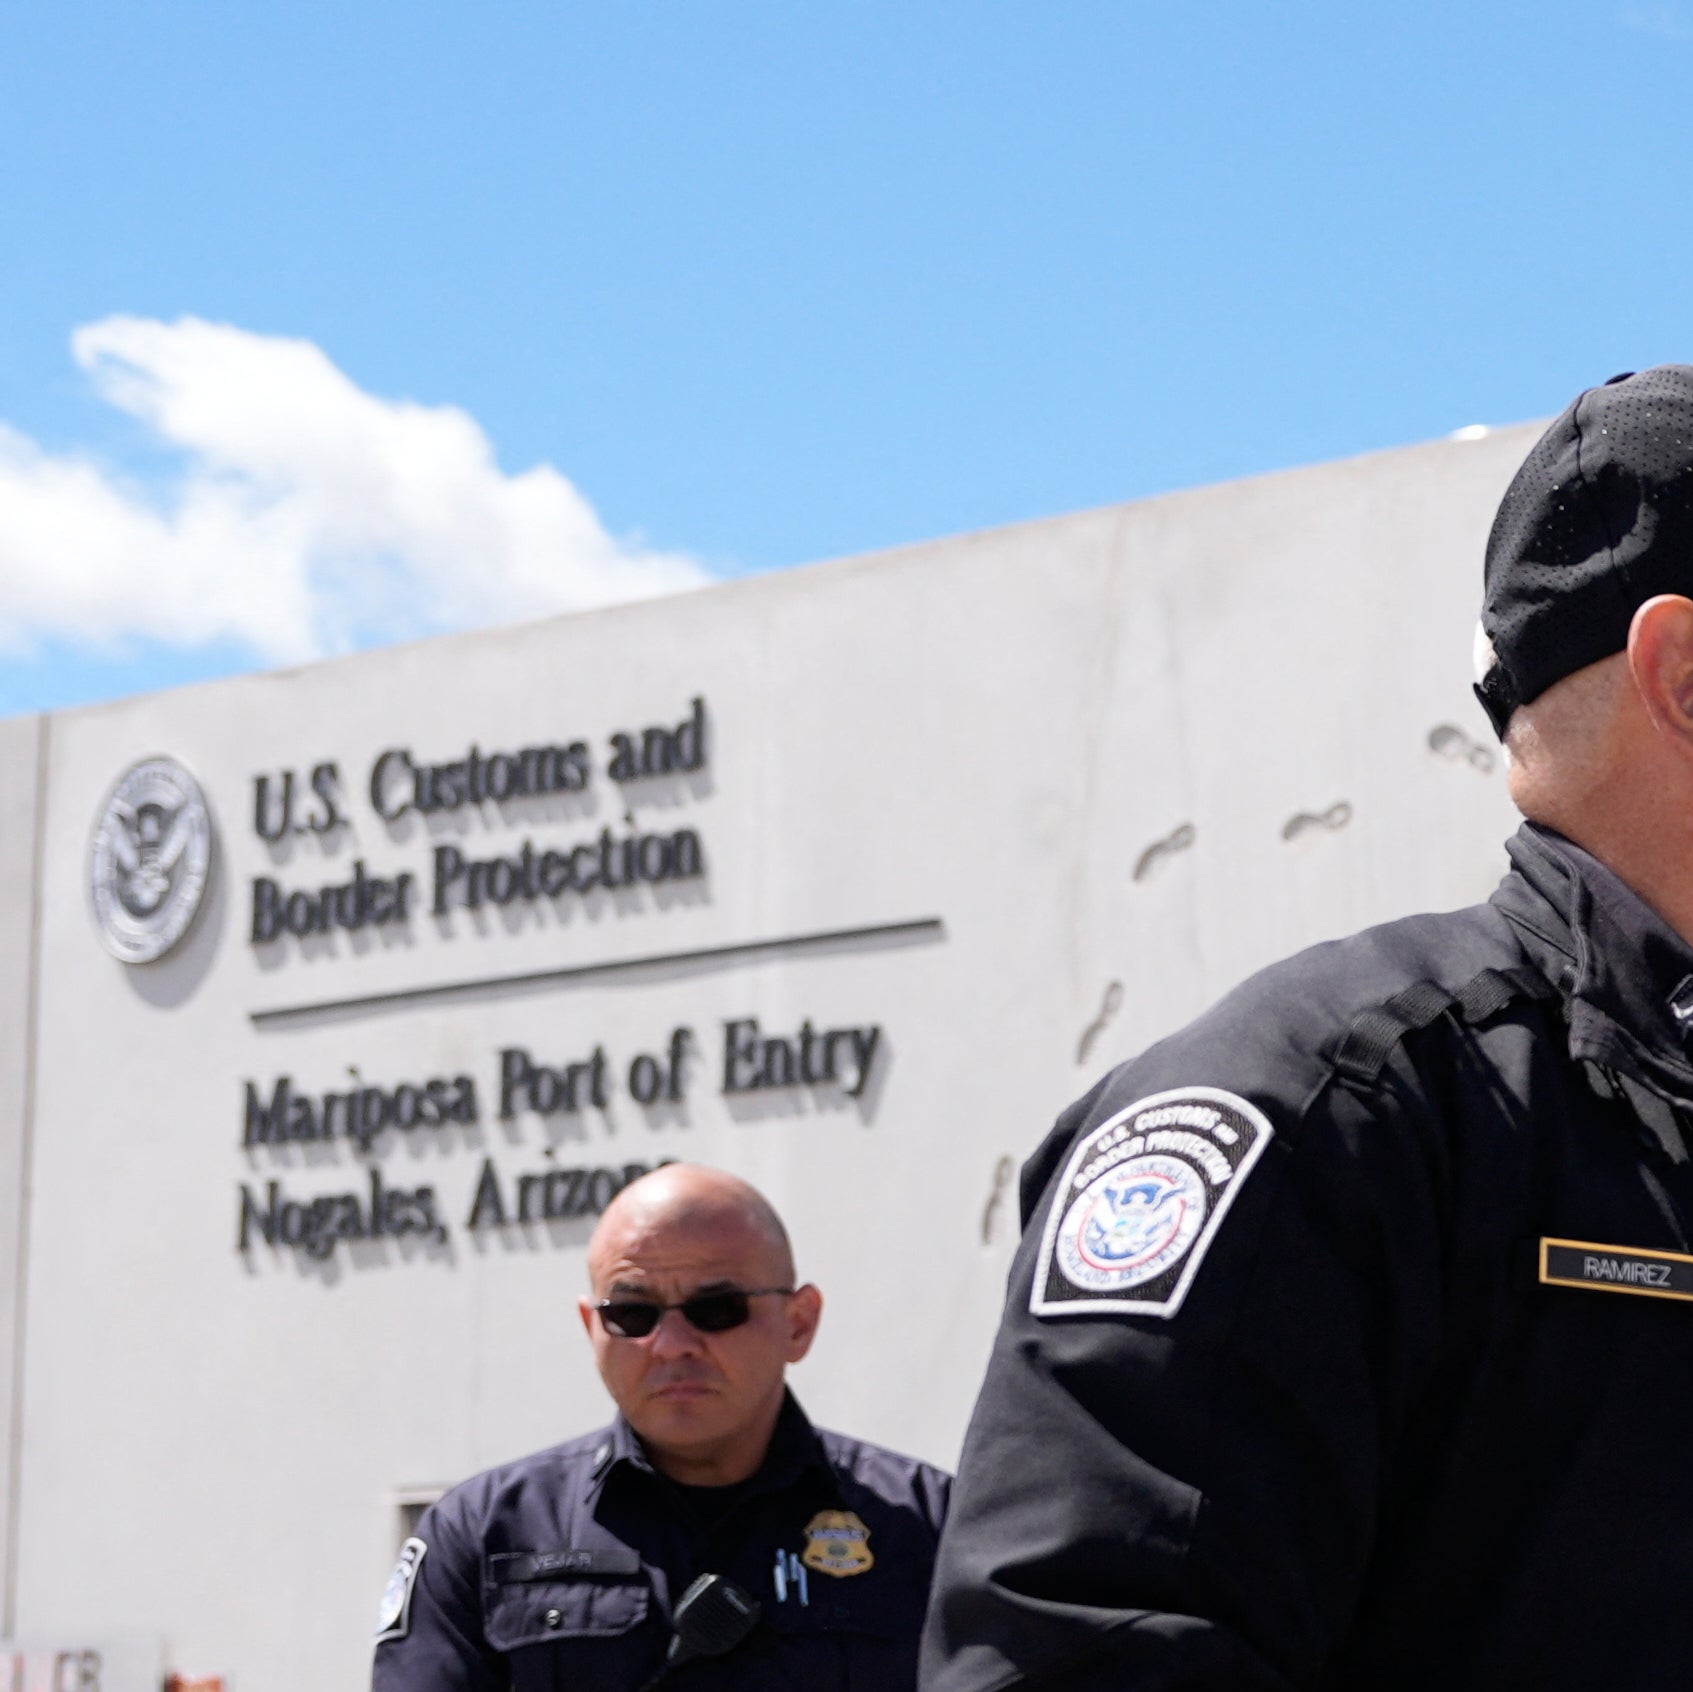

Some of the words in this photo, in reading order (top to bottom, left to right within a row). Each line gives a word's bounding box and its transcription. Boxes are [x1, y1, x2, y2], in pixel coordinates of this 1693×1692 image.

[253, 762, 347, 841] U.S.
[371, 742, 589, 820] Customs
[608, 695, 706, 781] and
[250, 860, 413, 944] Border
[433, 813, 704, 916] Protection
[242, 1066, 478, 1155] Mariposa
[497, 1044, 607, 1120] Port
[628, 1025, 694, 1102] of
[722, 1019, 882, 1098] Entry
[239, 1167, 449, 1260] Nogales,
[469, 1149, 681, 1230] Arizo
[1583, 1256, 1672, 1286] RAMIREZ
